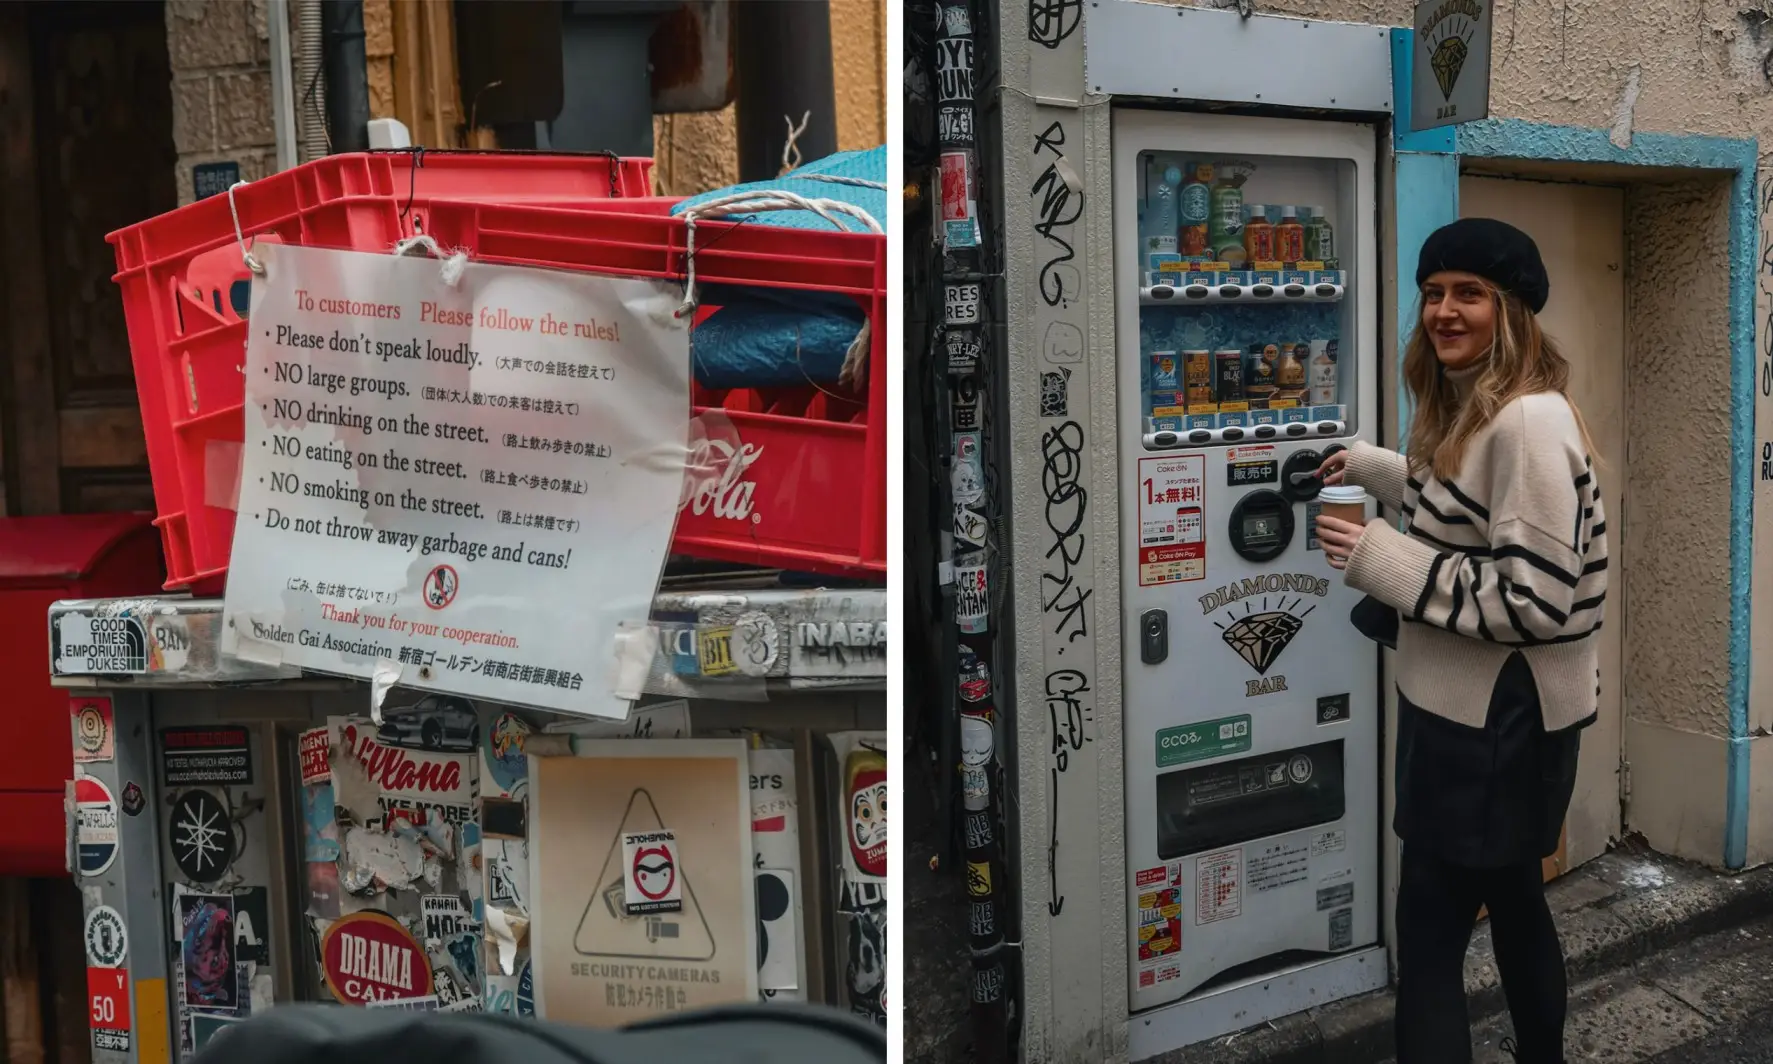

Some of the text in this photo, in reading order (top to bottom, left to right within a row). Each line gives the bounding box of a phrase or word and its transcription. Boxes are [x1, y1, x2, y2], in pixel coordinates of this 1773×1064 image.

[295, 289, 620, 343] To customers Please follow the rules!
[276, 325, 483, 371] Please don't speak loudly.
[275, 362, 410, 399] NO large groups.
[273, 399, 489, 445] NO drinking on the street.
[272, 435, 467, 480] NO eating on the street.
[1233, 466, 1272, 481] 販売中
[270, 472, 484, 520] NO smoking on the street.
[265, 508, 572, 571] Do not throw away garbage and cans!
[1198, 573, 1330, 616] DIAMONDS
[90, 619, 126, 632] GOOD
[91, 632, 126, 645] TIMES
[253, 621, 392, 659] Golden Gai Association
[321, 602, 520, 650] Thank you for your cooperation.
[87, 658, 127, 671] DUKES
[397, 646, 584, 692] 新宿ゴールデン街商店街振興組合
[1245, 674, 1288, 697] BAR
[424, 898, 458, 911] KAWAII
[340, 932, 413, 991] DRAMA
[570, 962, 720, 984] SECURITY CAMERAS
[116, 974, 124, 989] Y
[92, 996, 115, 1023] 50
